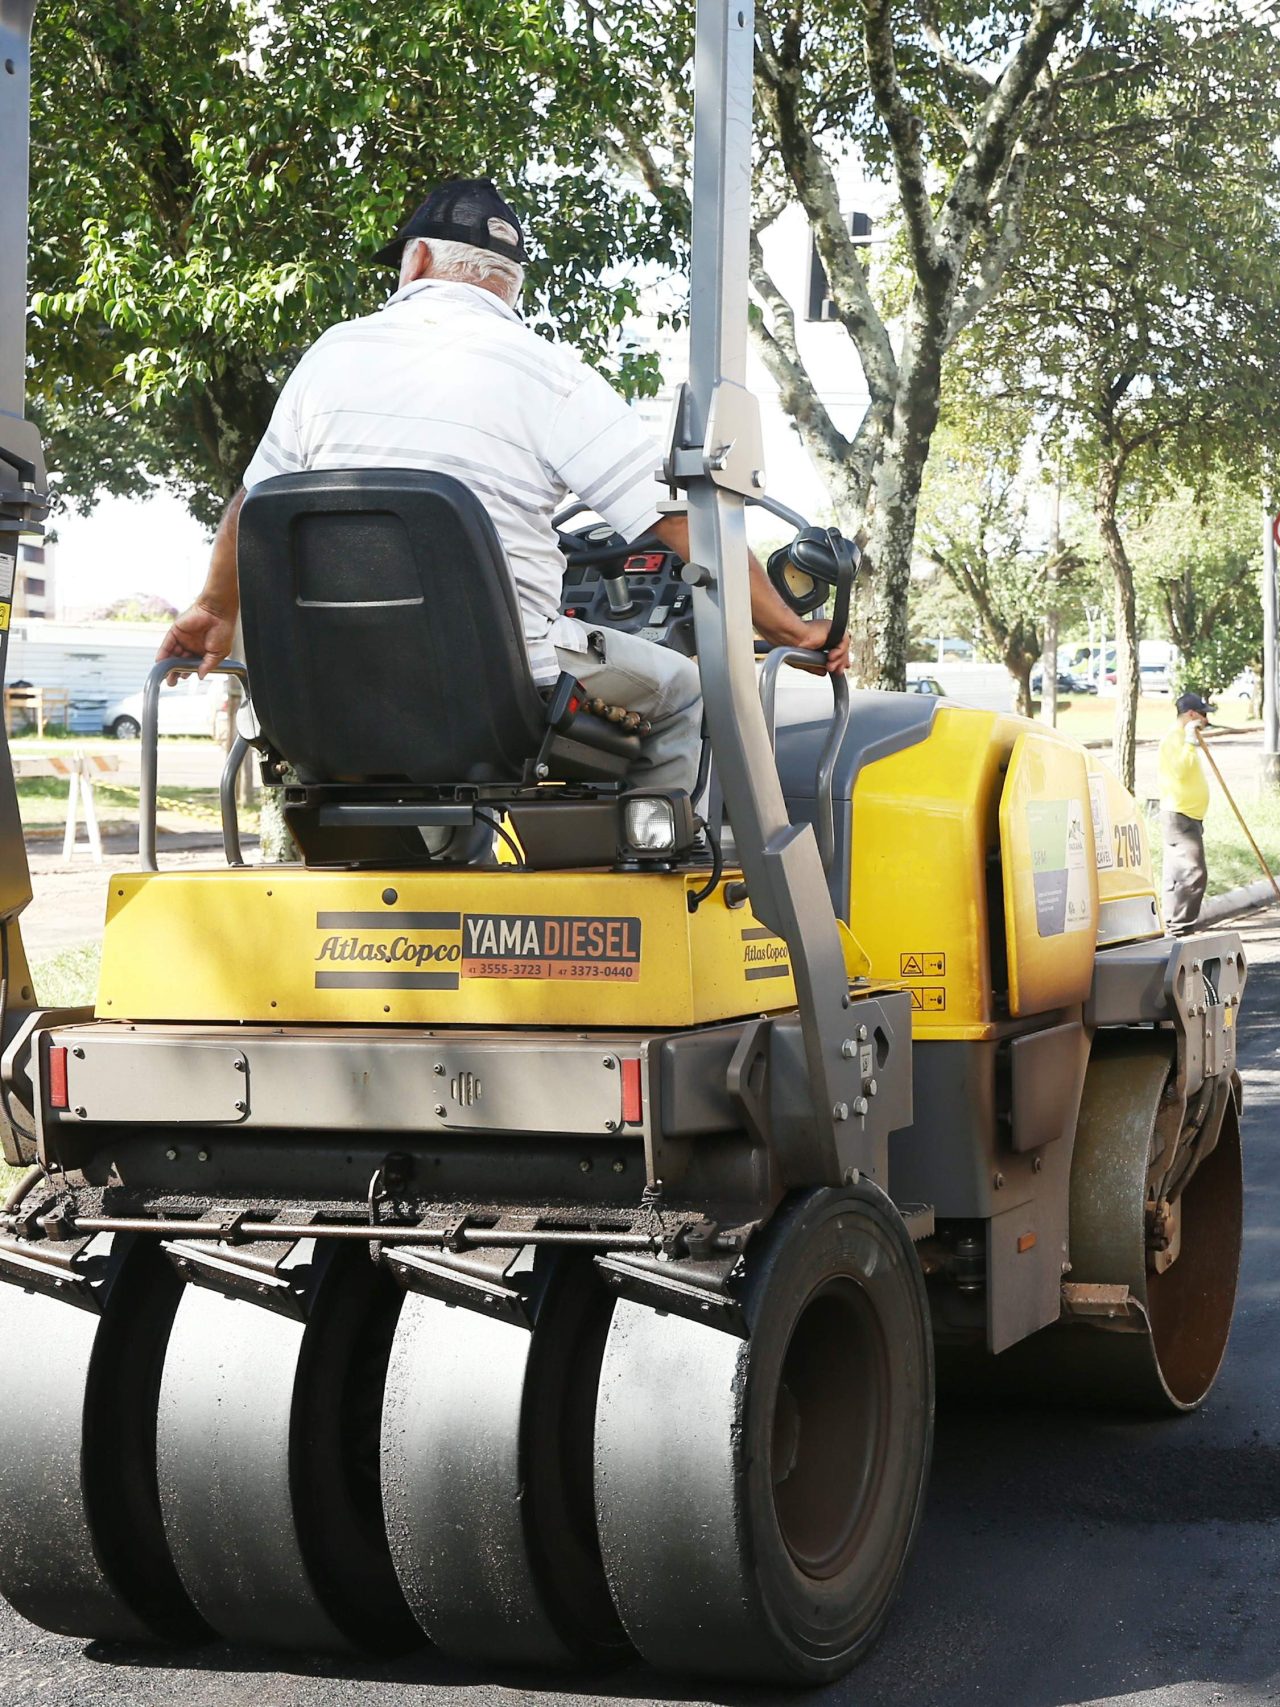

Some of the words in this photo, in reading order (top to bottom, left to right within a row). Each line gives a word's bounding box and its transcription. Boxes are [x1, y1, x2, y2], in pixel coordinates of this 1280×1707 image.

[1096, 850, 1111, 864] CAVEL
[1114, 823, 1142, 868] 2799
[466, 918, 540, 956] YAMA
[544, 921, 637, 958] DIESEL
[314, 935, 388, 961] Atlas
[389, 936, 461, 967] Copco
[743, 945, 766, 962] Atlas
[766, 943, 788, 962] Copco
[480, 963, 541, 975] 3555-3723
[571, 965, 633, 978] 3373-0440
